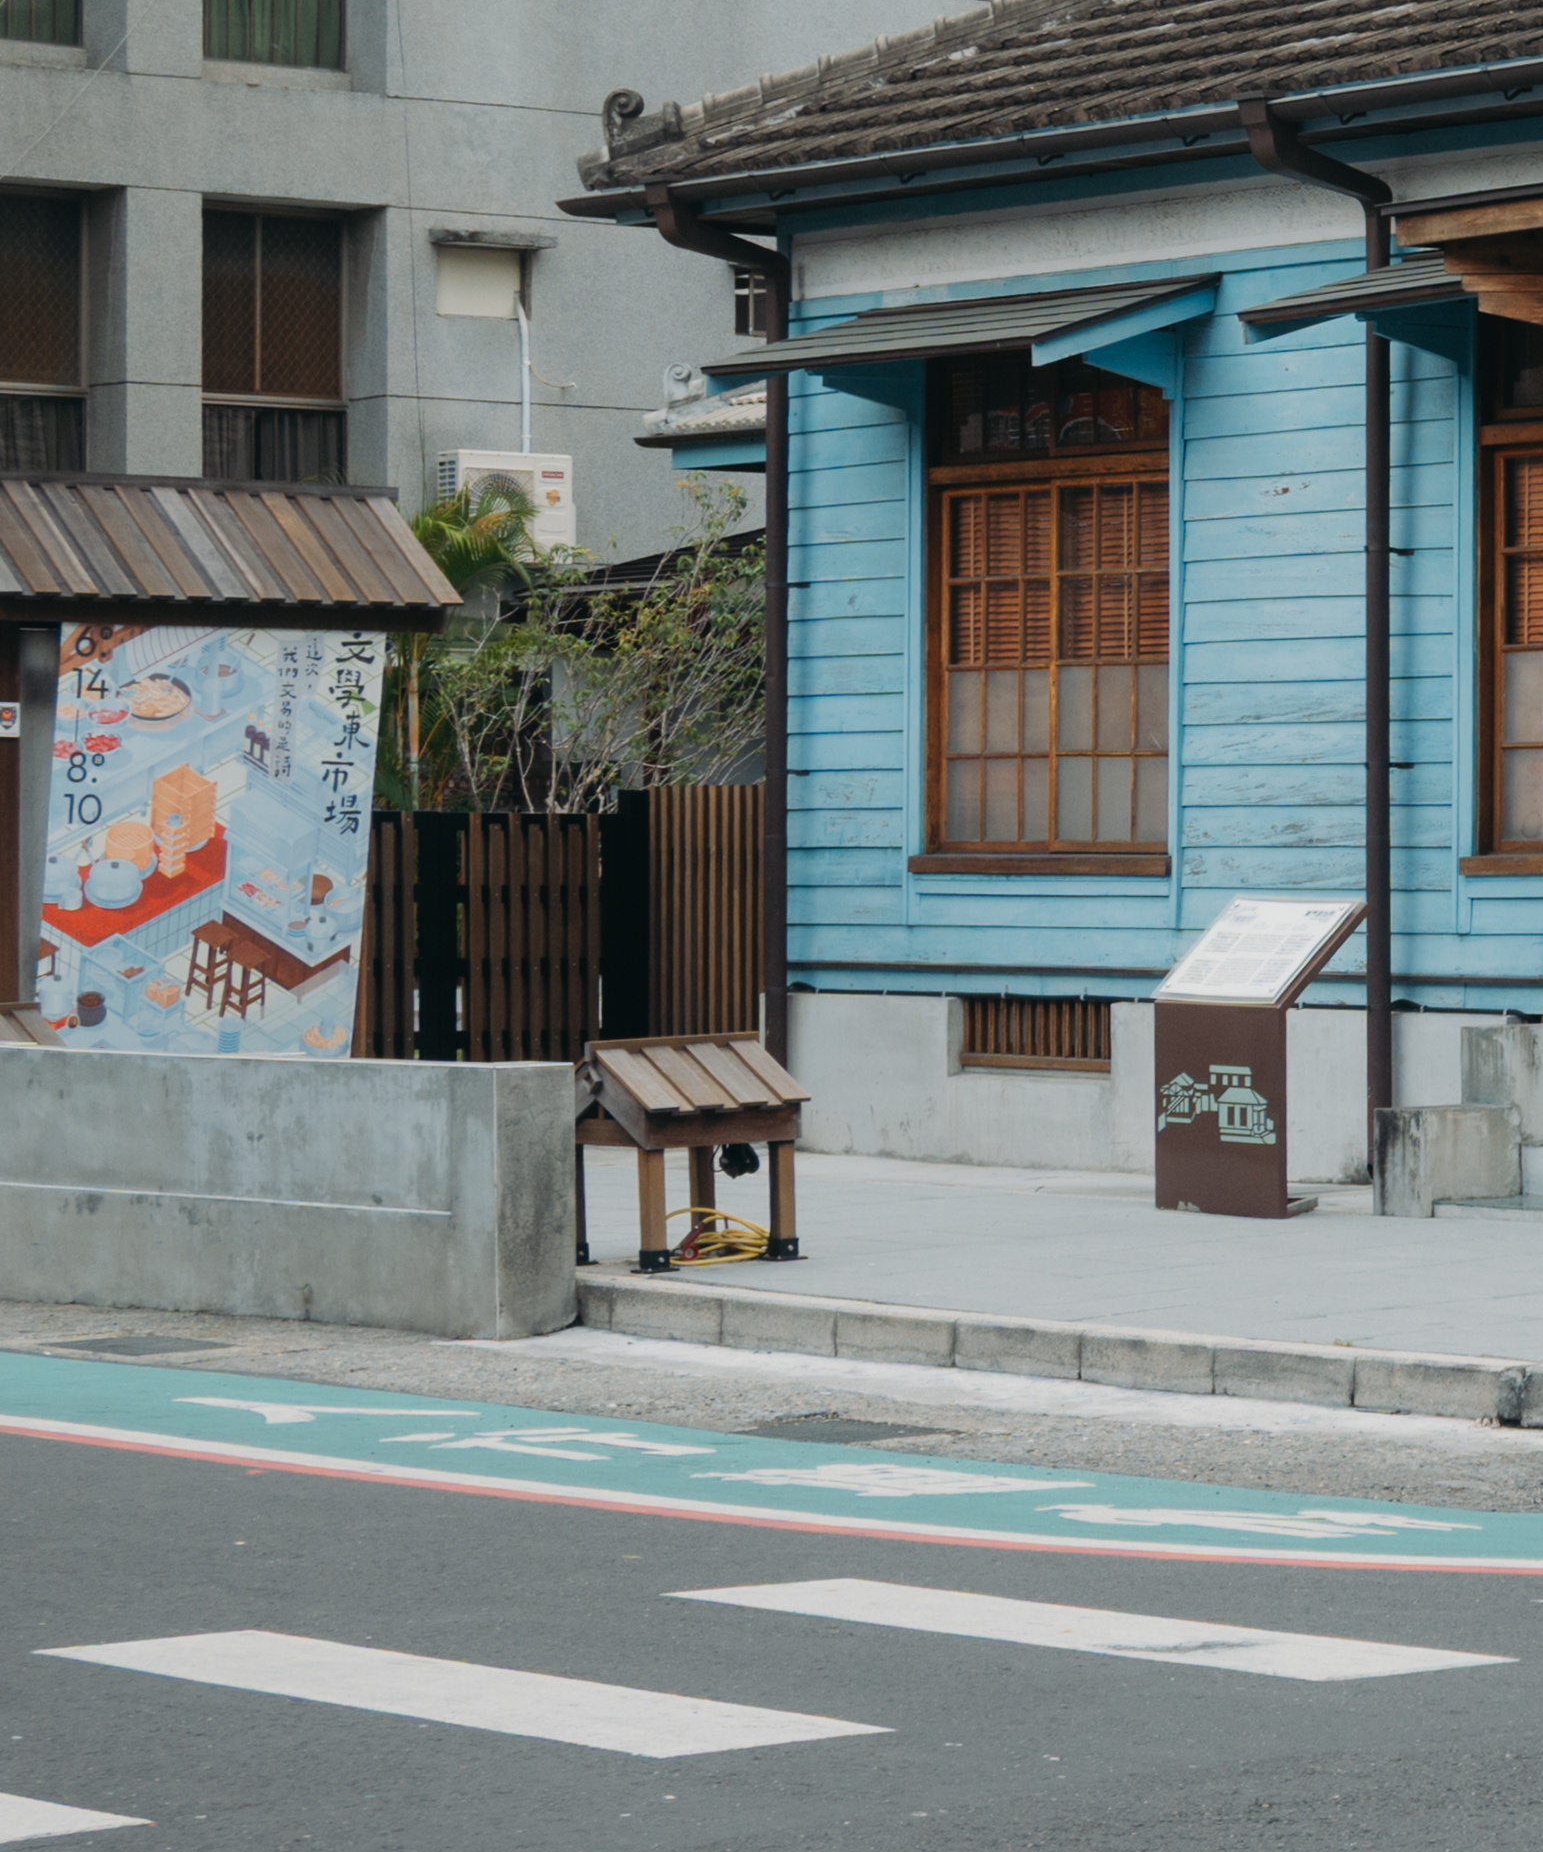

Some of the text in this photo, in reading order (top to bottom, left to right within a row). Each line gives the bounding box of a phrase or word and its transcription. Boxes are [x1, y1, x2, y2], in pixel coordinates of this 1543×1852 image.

[72, 668, 109, 699] 14
[273, 646, 299, 778] 我們交易的是詩
[321, 632, 375, 835] 文學東市場
[64, 794, 103, 825] 10
